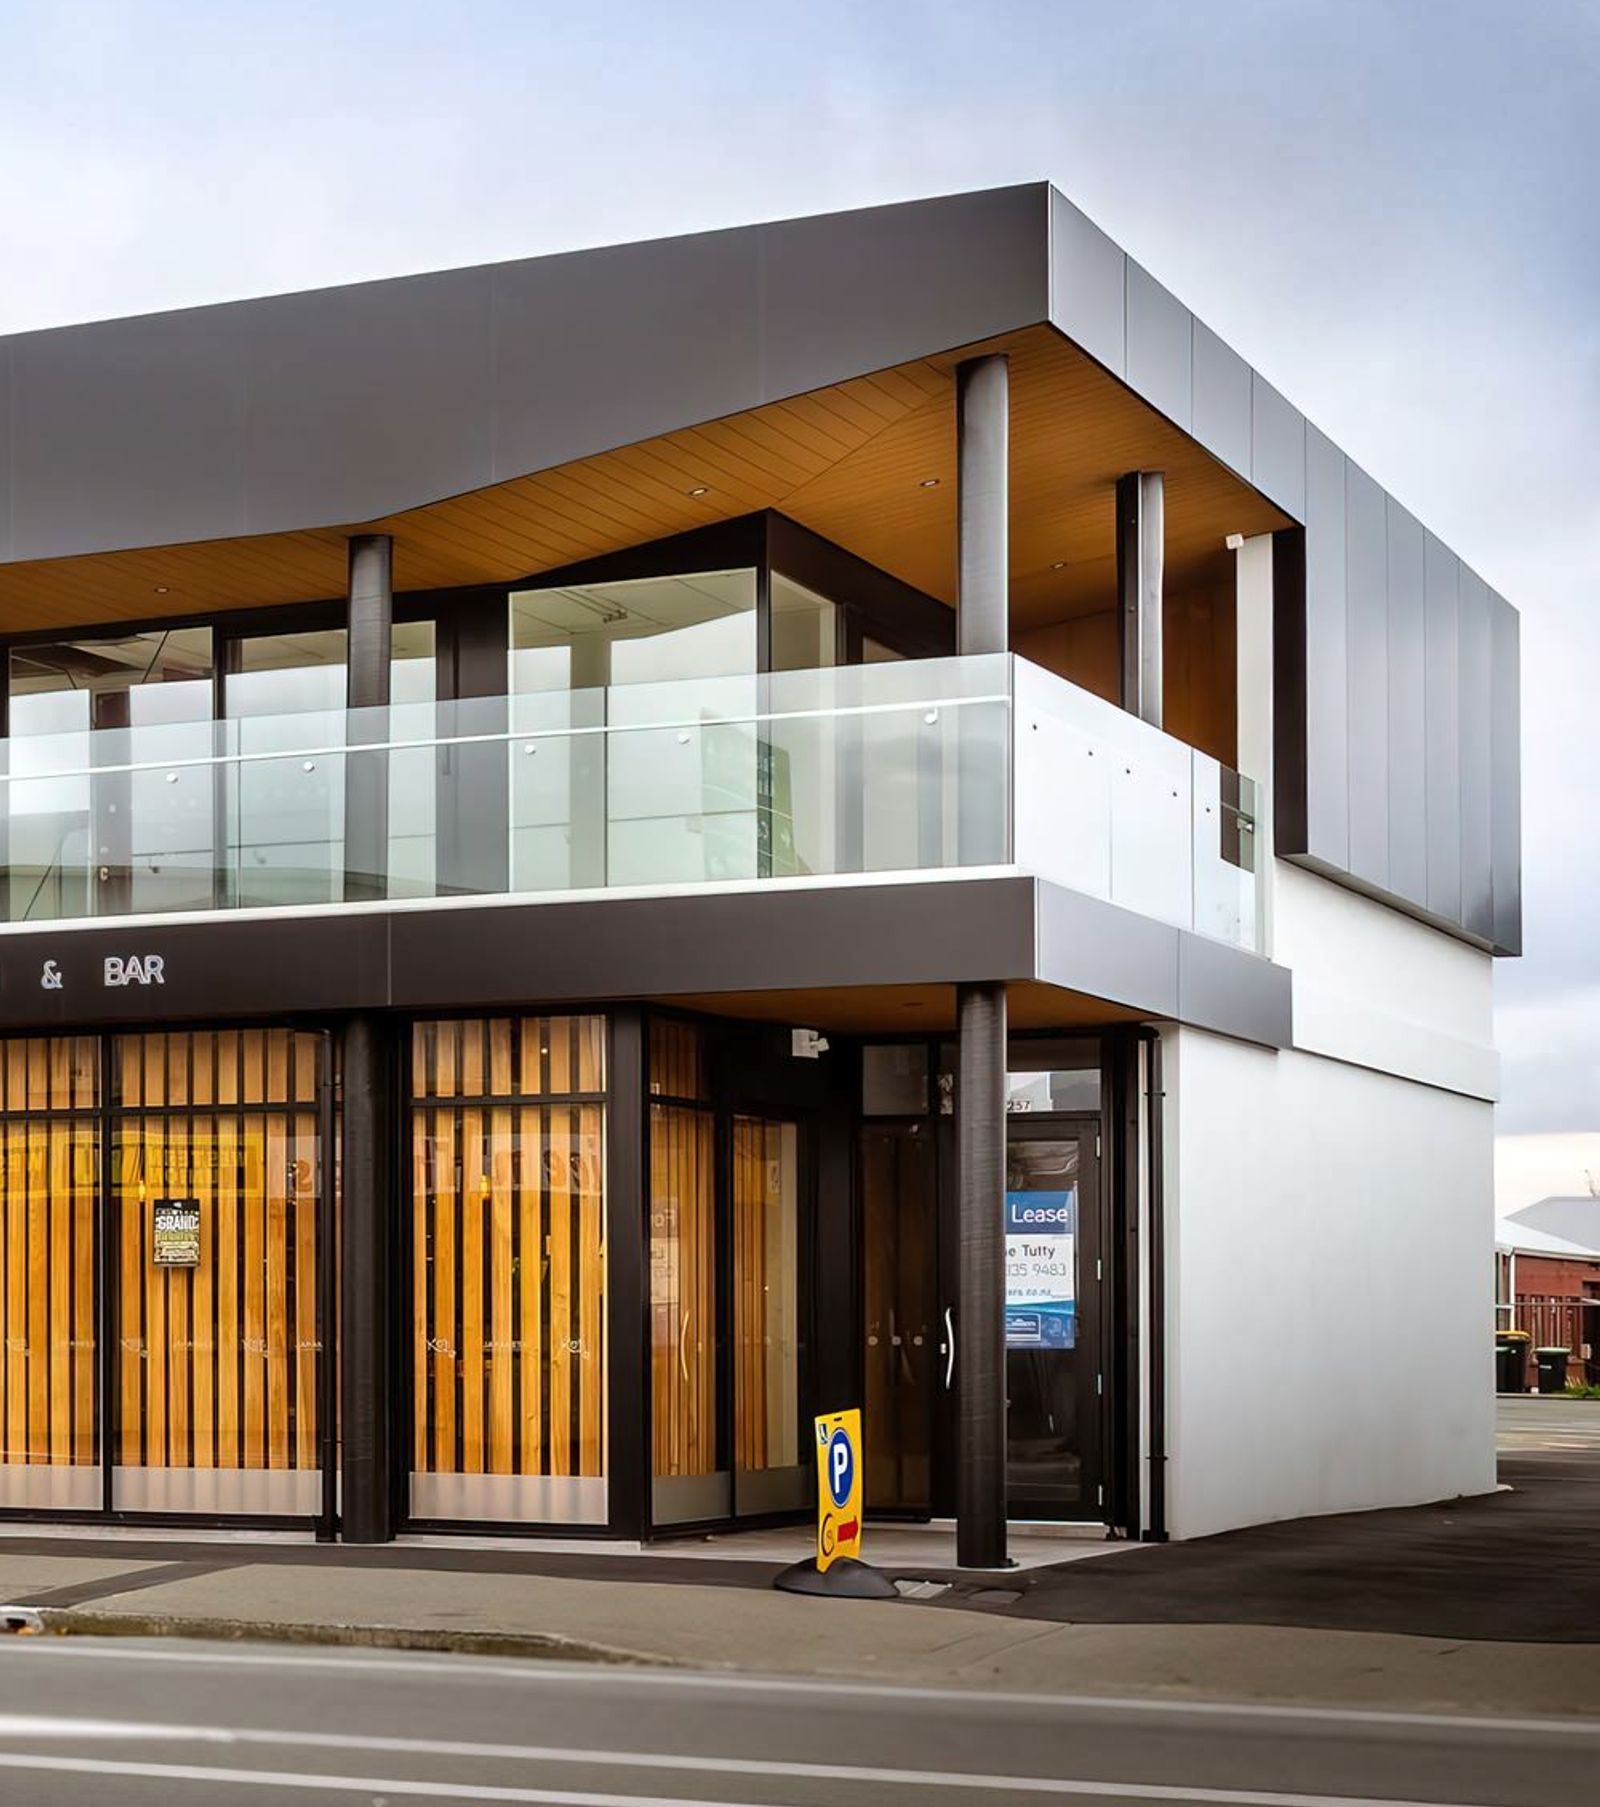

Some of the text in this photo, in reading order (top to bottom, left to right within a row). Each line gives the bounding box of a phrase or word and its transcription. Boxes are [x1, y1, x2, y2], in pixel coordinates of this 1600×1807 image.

[41, 960, 63, 990] &
[104, 954, 164, 987] BAR
[1011, 1204, 1069, 1223] Lease
[1022, 1244, 1056, 1260] Tutty
[833, 1442, 848, 1494] P
